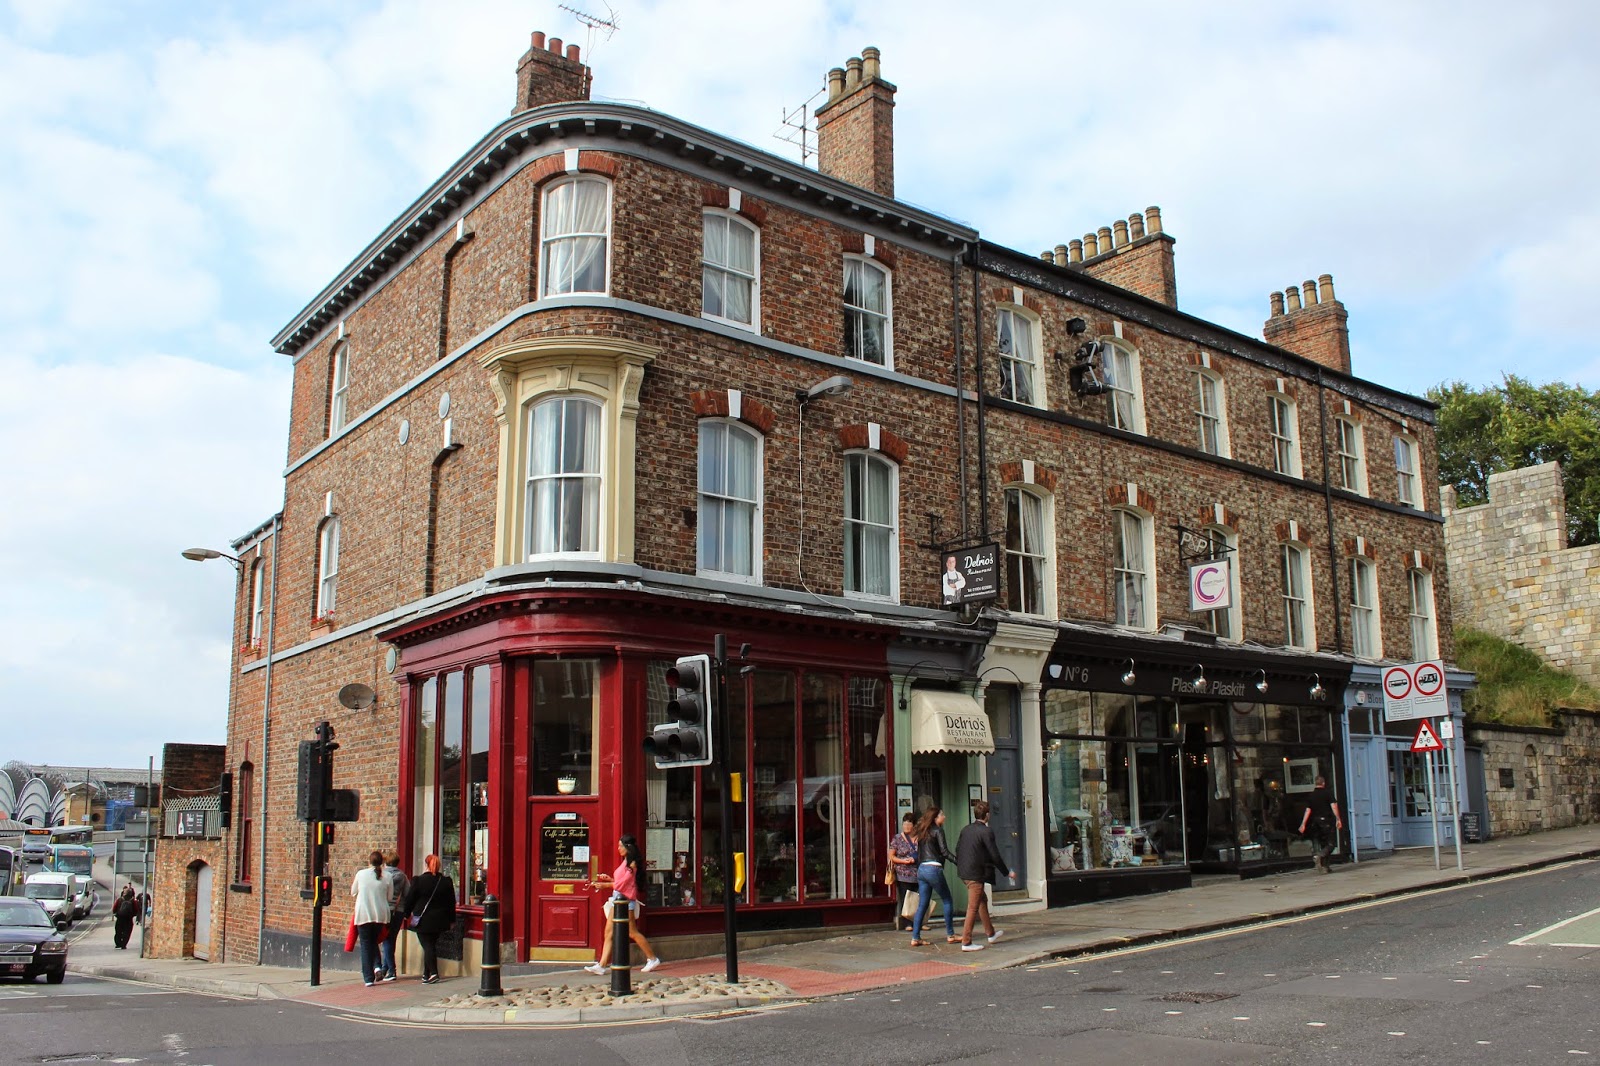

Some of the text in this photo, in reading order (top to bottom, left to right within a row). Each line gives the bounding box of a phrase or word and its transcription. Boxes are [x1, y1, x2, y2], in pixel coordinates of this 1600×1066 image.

[964, 552, 994, 568] Delrio's
[1082, 668, 1088, 683] 6
[1211, 680, 1246, 696] Plaskitt
[945, 716, 986, 731] Delrio's
[947, 730, 986, 738] RESTAURANT
